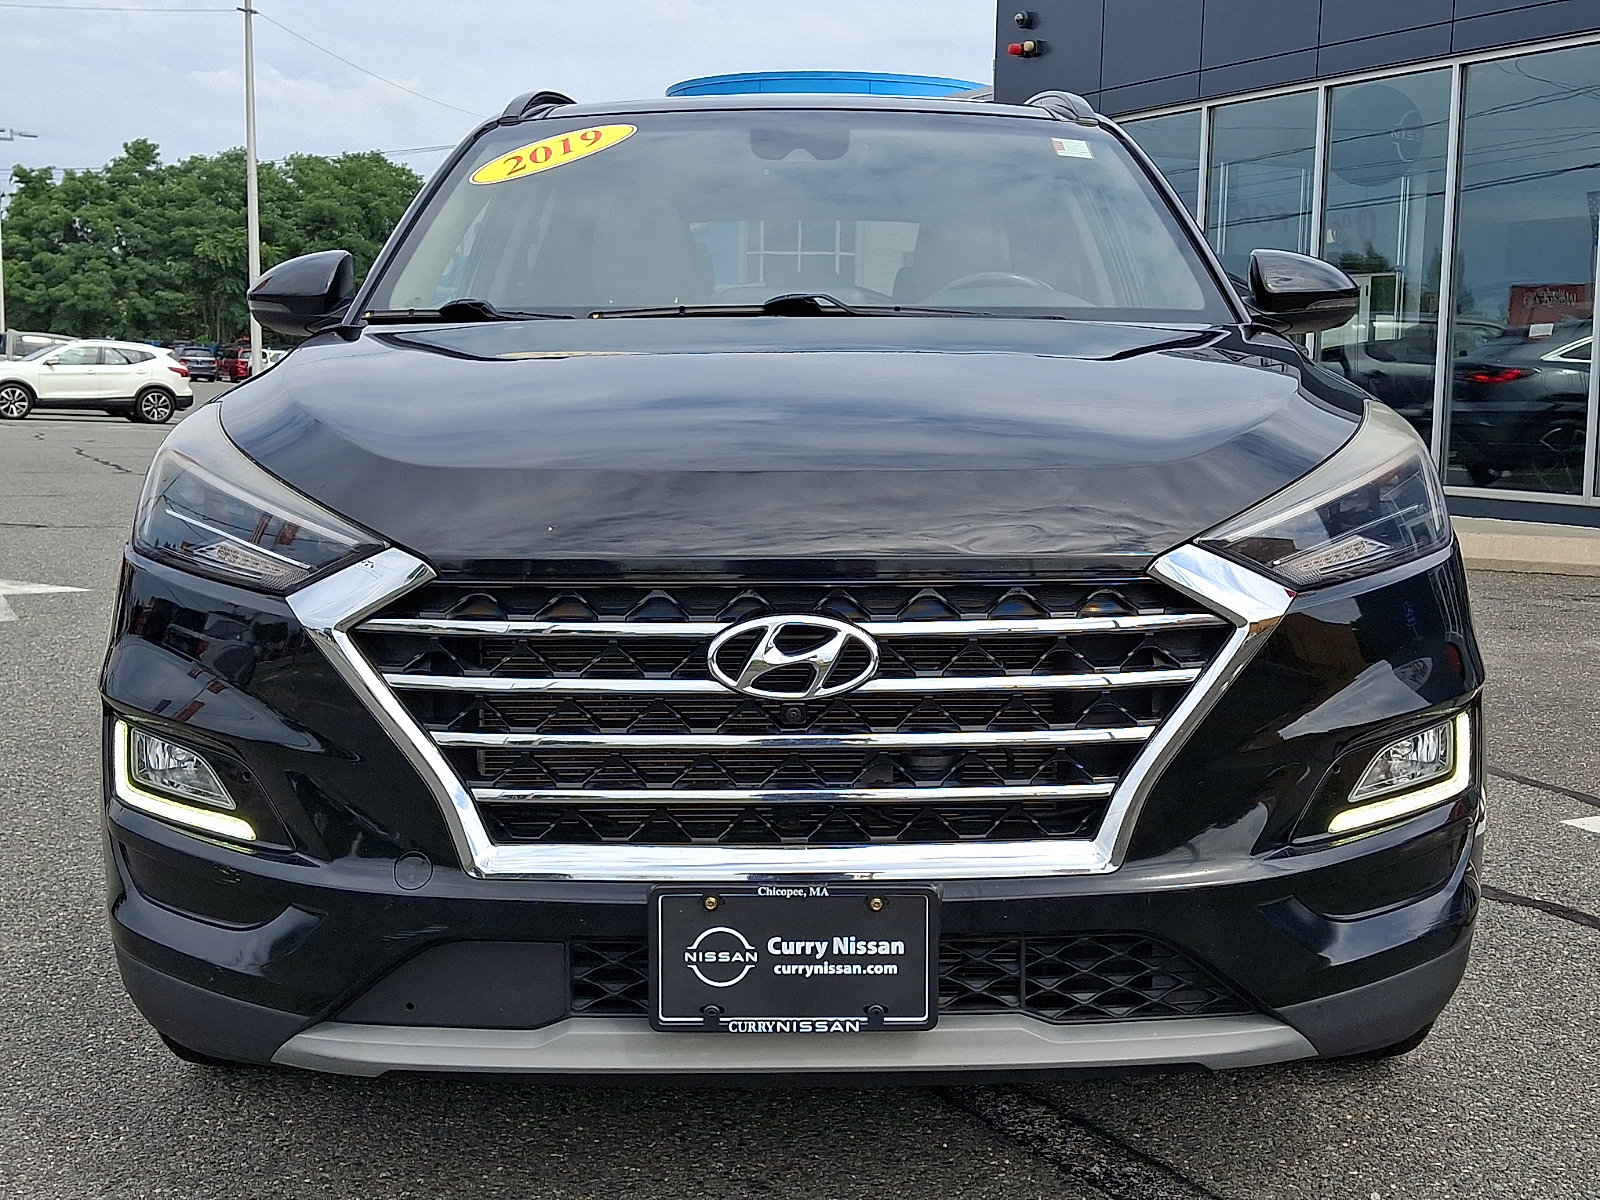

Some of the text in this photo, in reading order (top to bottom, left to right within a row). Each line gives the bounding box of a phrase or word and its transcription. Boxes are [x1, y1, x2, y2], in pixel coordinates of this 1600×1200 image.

[503, 130, 603, 176] 2019
[757, 886, 829, 898] Chicopee, MA
[767, 936, 905, 959] Curry Nissan
[684, 951, 758, 963] NISSAN
[773, 961, 898, 977] currynissan.com
